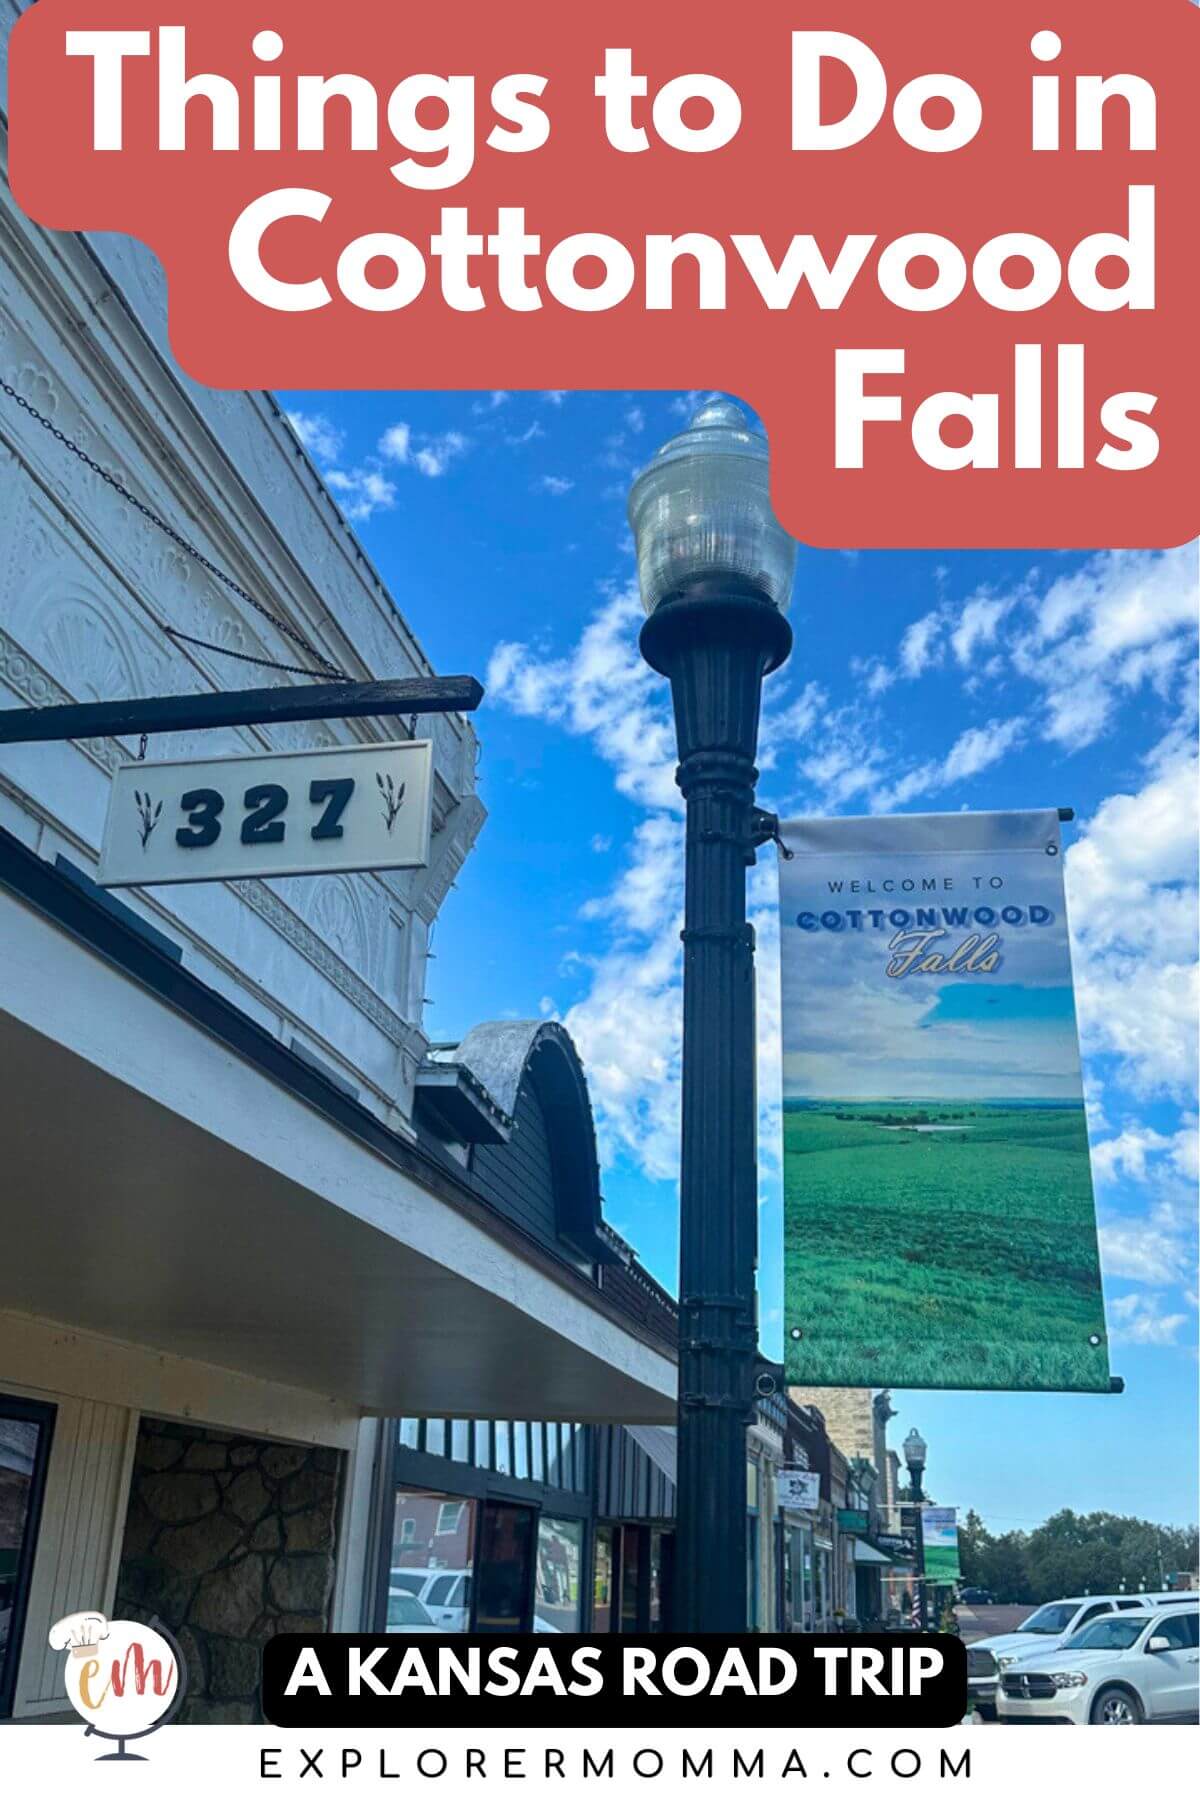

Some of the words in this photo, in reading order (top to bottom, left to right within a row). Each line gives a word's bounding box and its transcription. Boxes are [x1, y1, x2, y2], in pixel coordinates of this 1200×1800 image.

[176, 778, 355, 848] 327
[827, 877, 954, 894] WELCOME
[973, 876, 1004, 890] TO
[796, 904, 1054, 932] COTTONWOOD
[886, 928, 1002, 978] Falls
